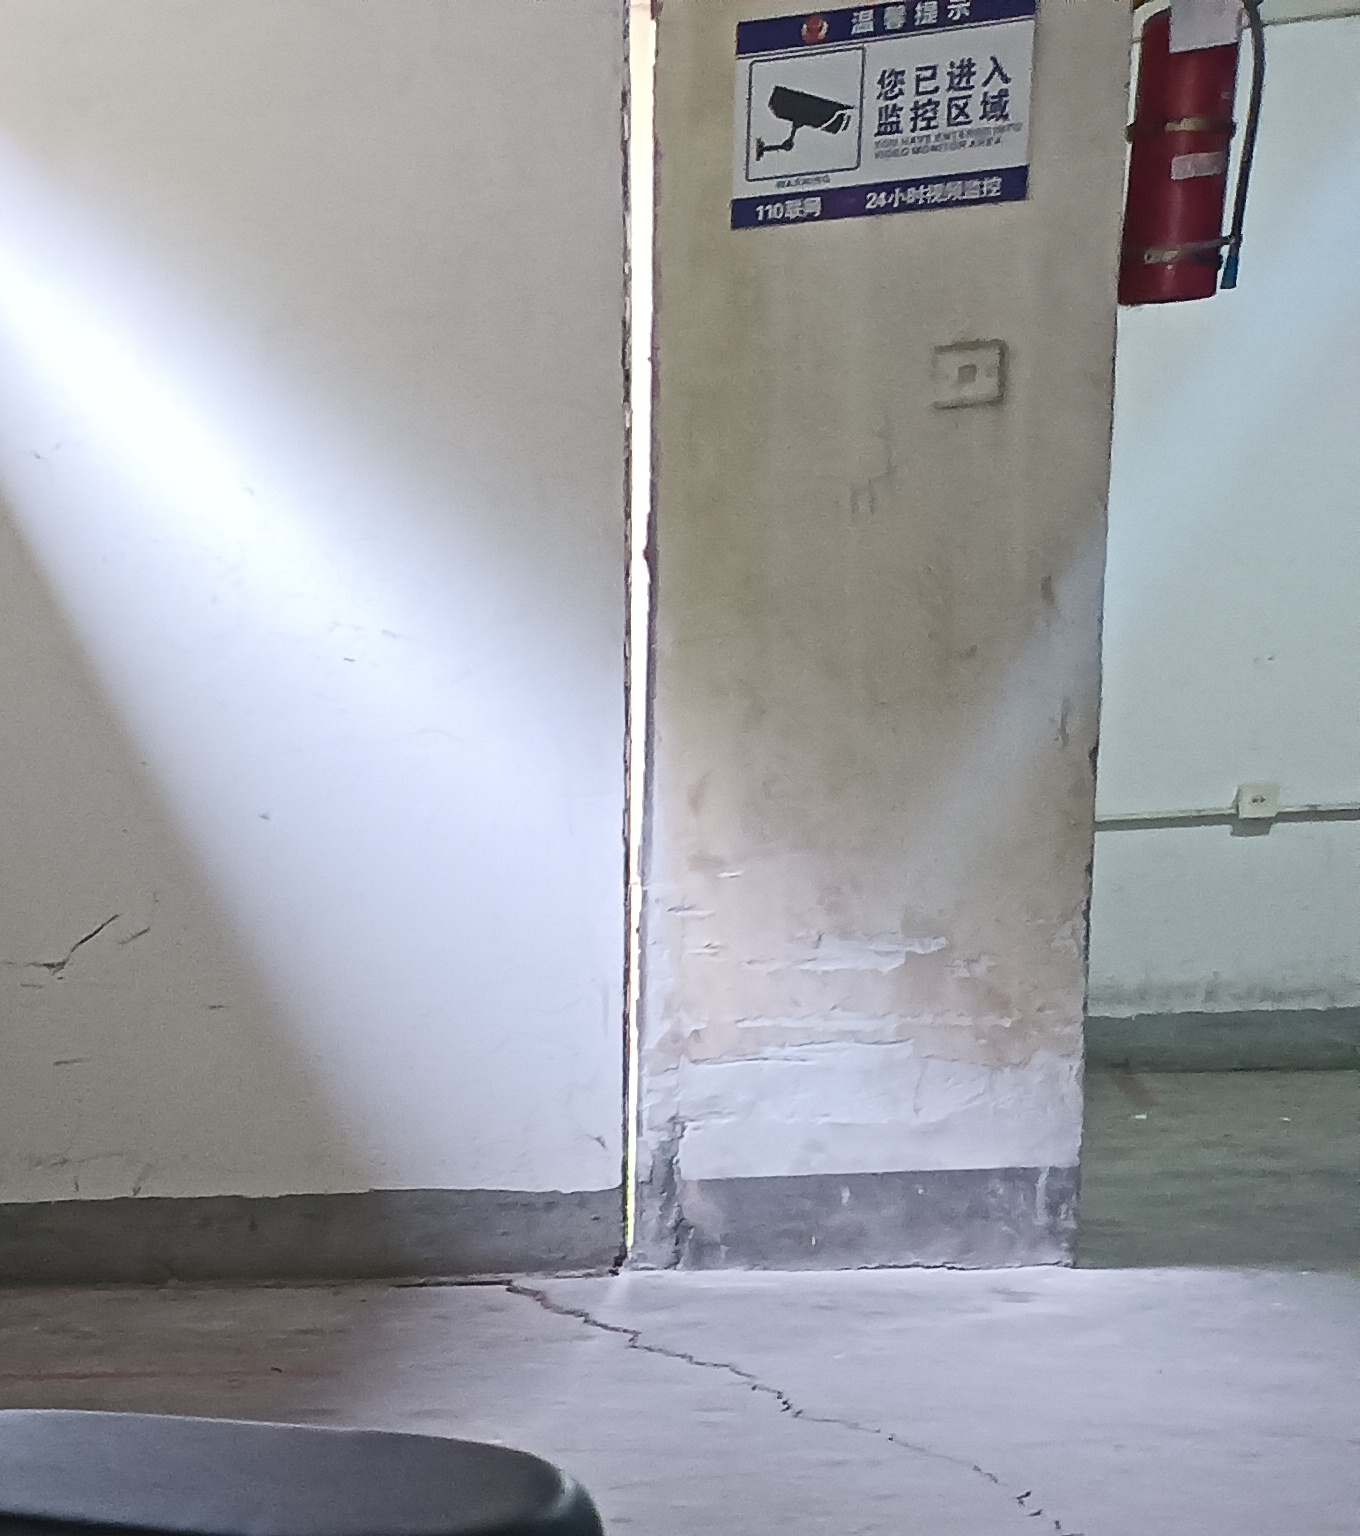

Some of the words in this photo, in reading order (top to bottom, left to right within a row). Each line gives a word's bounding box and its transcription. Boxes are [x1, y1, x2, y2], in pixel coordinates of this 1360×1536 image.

[876, 56, 1012, 101] 您已进入
[874, 89, 1011, 137] 监控区域
